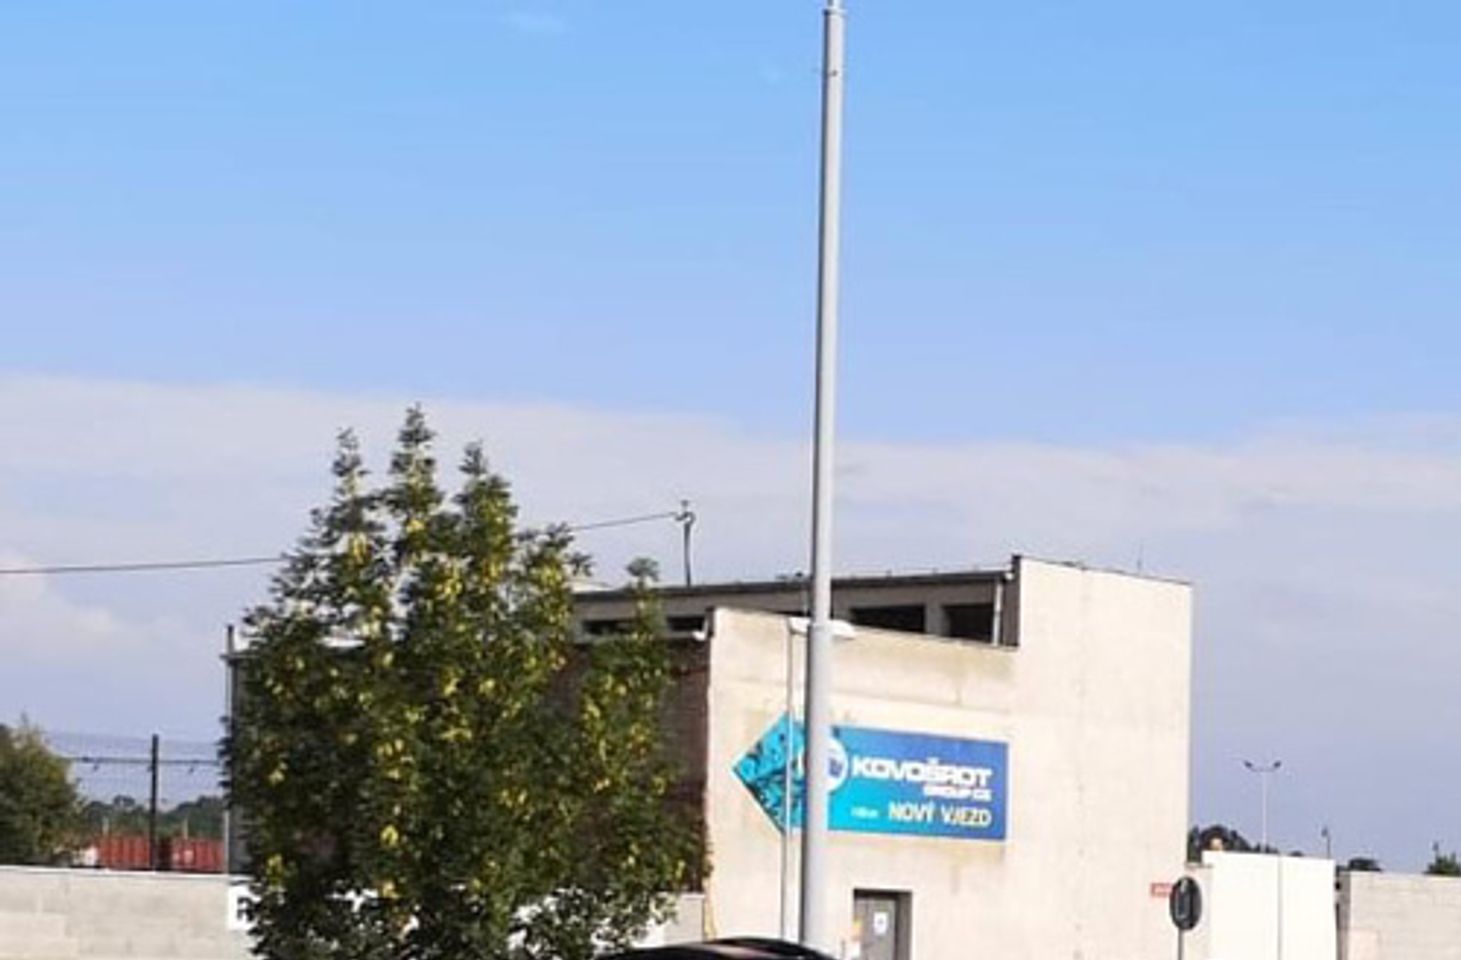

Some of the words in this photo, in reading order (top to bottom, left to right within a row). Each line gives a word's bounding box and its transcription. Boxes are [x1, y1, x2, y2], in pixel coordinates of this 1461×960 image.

[851, 754, 993, 788] KOVOŠROT
[888, 800, 936, 824] NOVÝ
[940, 803, 992, 829] VJEZD
